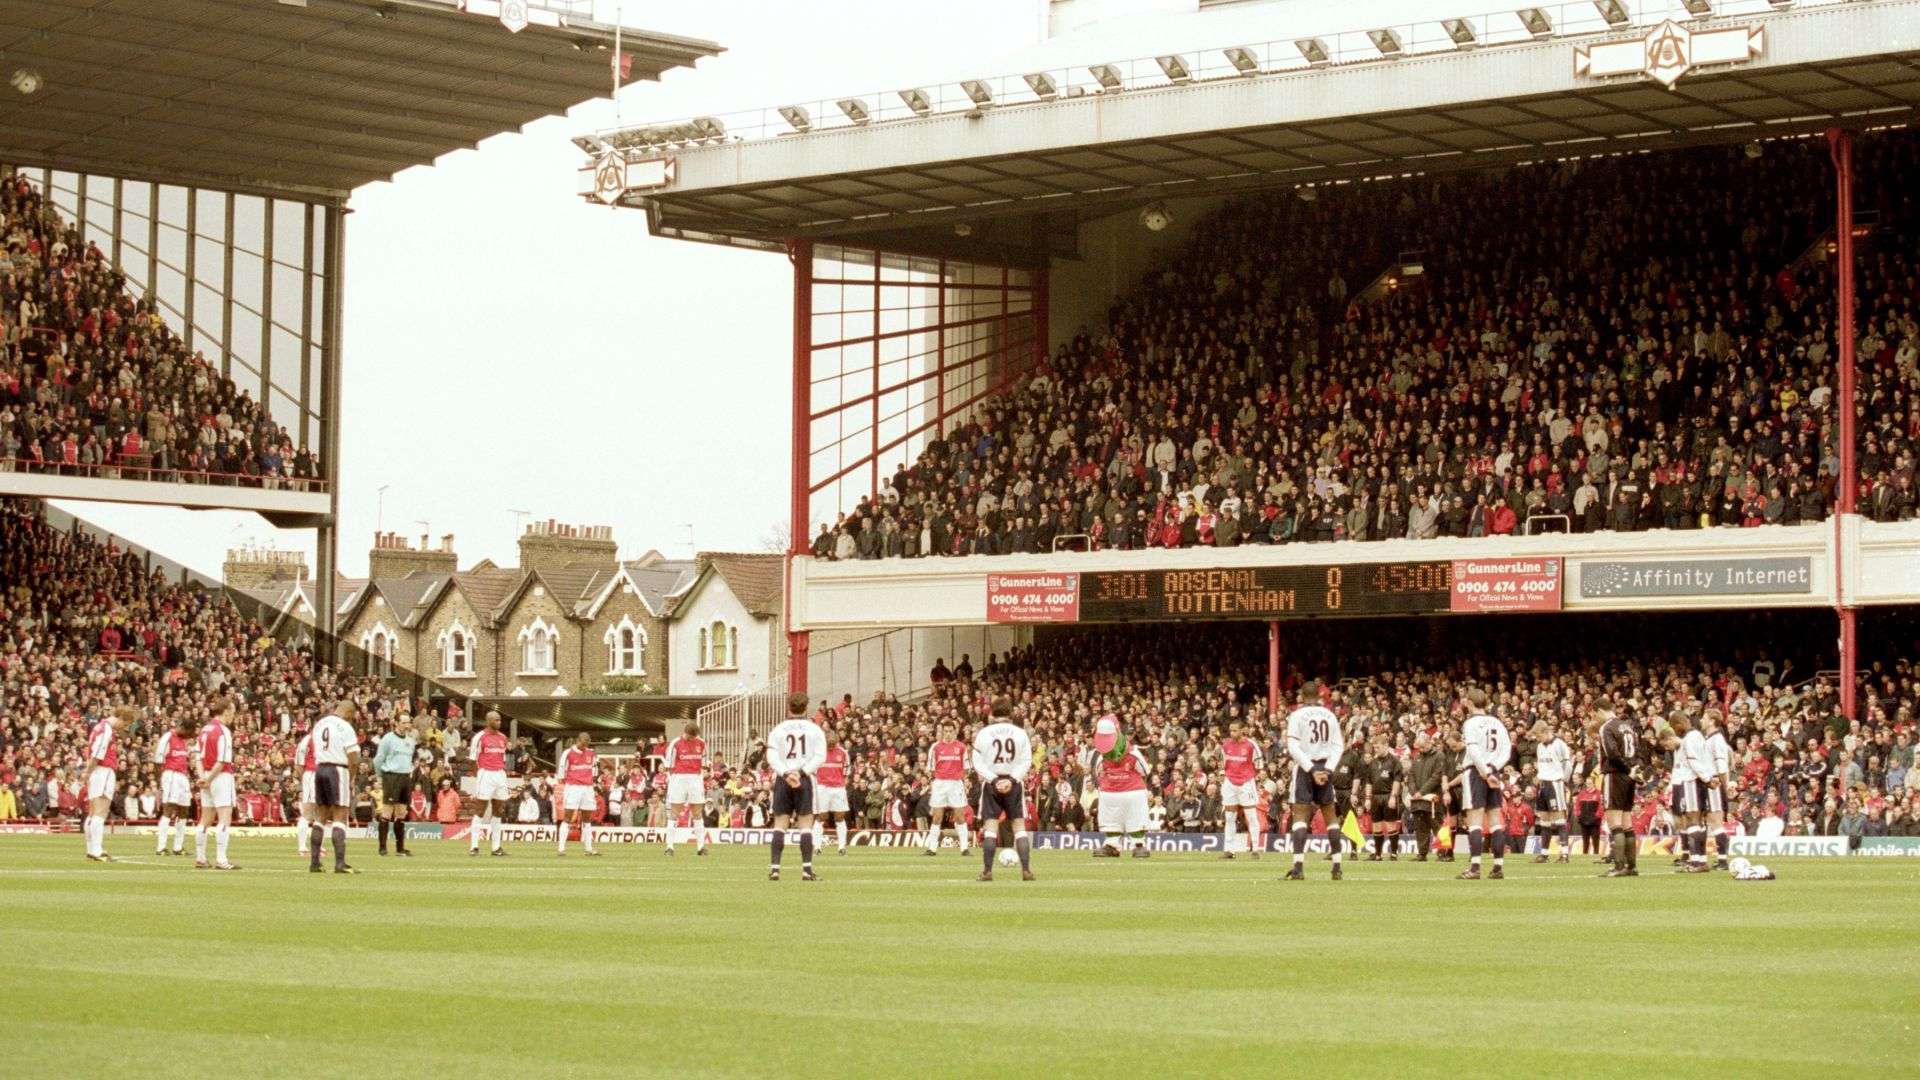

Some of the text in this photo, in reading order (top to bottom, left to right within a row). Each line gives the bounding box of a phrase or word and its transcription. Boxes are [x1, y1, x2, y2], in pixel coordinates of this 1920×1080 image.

[1467, 561, 1541, 574] GunnersLine
[1632, 565, 1808, 588] Affinity Internet
[1000, 576, 1063, 587] GunnersLine
[1098, 574, 1148, 599] 3:01
[1164, 567, 1341, 592] ARSENAL 0
[1456, 580, 1554, 593] 0906 474 4000
[991, 593, 1073, 605] 0906 474 4000
[1165, 588, 1341, 613] TOTTENHAM 0
[322, 727, 330, 751] 9
[1309, 719, 1329, 744] 30
[1486, 729, 1497, 752] 15
[786, 734, 806, 759] 21
[993, 738, 1015, 764] 29
[489, 827, 558, 842] ITROËN
[1731, 842, 1840, 856] SIEMENS
